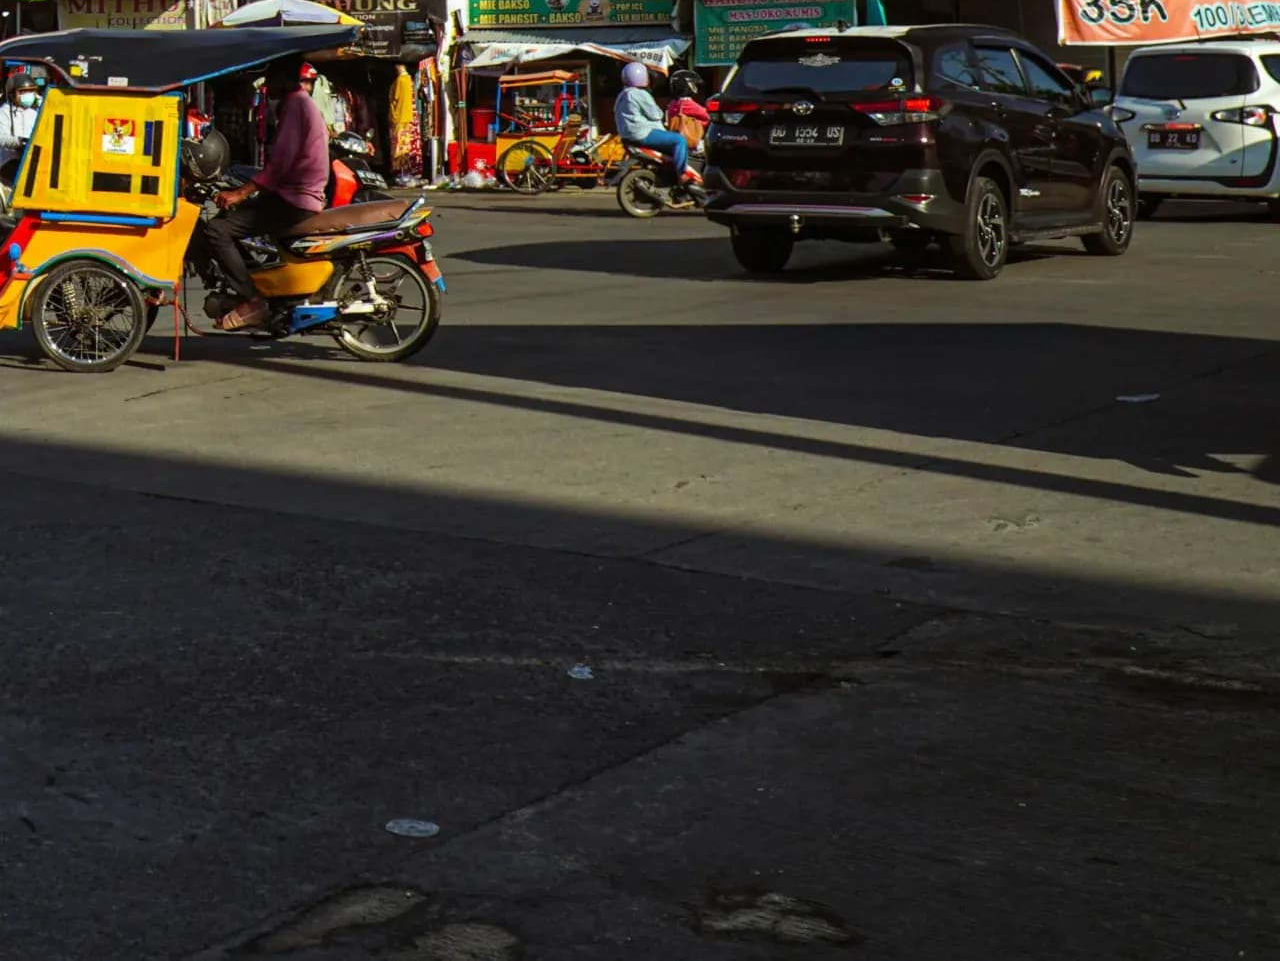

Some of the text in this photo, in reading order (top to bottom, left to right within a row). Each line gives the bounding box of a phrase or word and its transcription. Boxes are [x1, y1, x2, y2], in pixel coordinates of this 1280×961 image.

[479, 0, 530, 10] MIE BAKSO
[480, 13, 497, 24] MIE
[498, 13, 538, 24] PANGSIT
[549, 12, 582, 23] BAKSO
